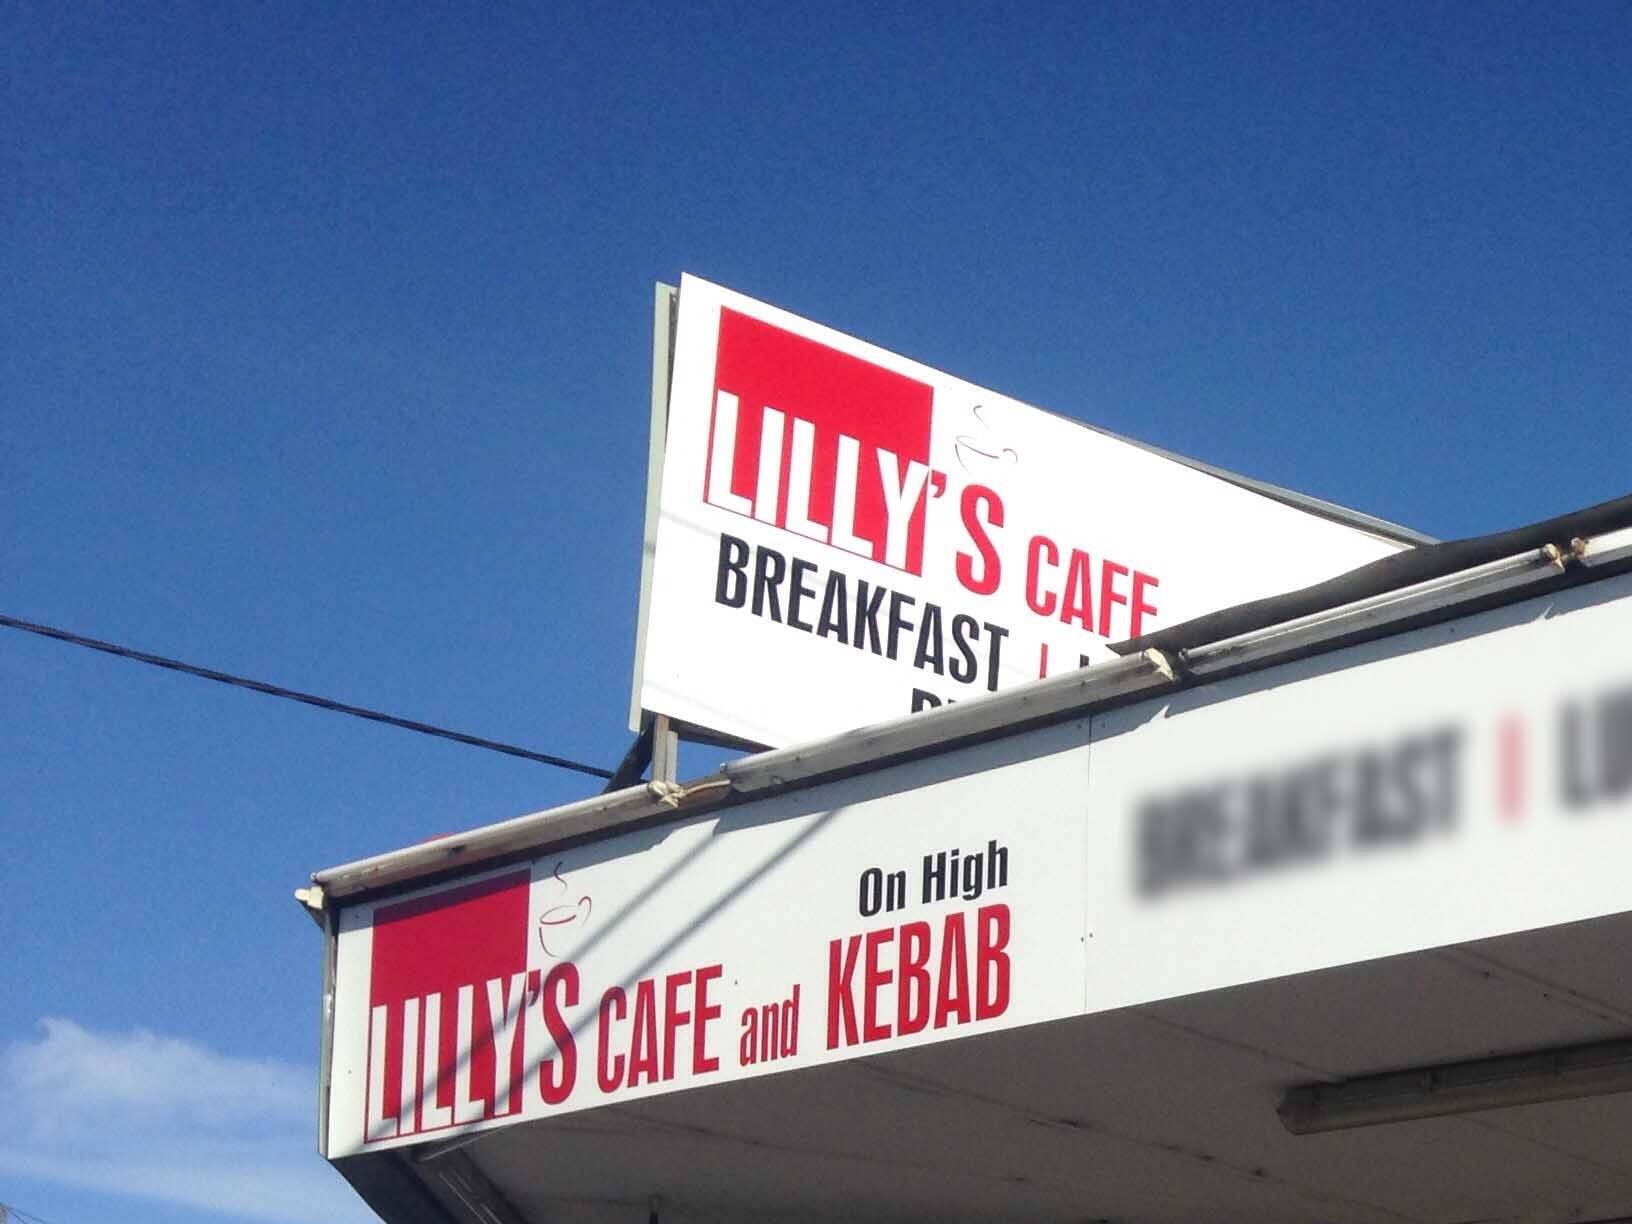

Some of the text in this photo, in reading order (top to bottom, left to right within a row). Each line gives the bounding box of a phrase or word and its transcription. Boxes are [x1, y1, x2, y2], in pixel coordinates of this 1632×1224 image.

[706, 389, 1160, 640] LILLY'S CAFE
[714, 531, 1009, 692] BREAKFAST
[858, 839, 1009, 917] On High
[364, 902, 1012, 1144] LILLY'S CAFE and KEBAB
